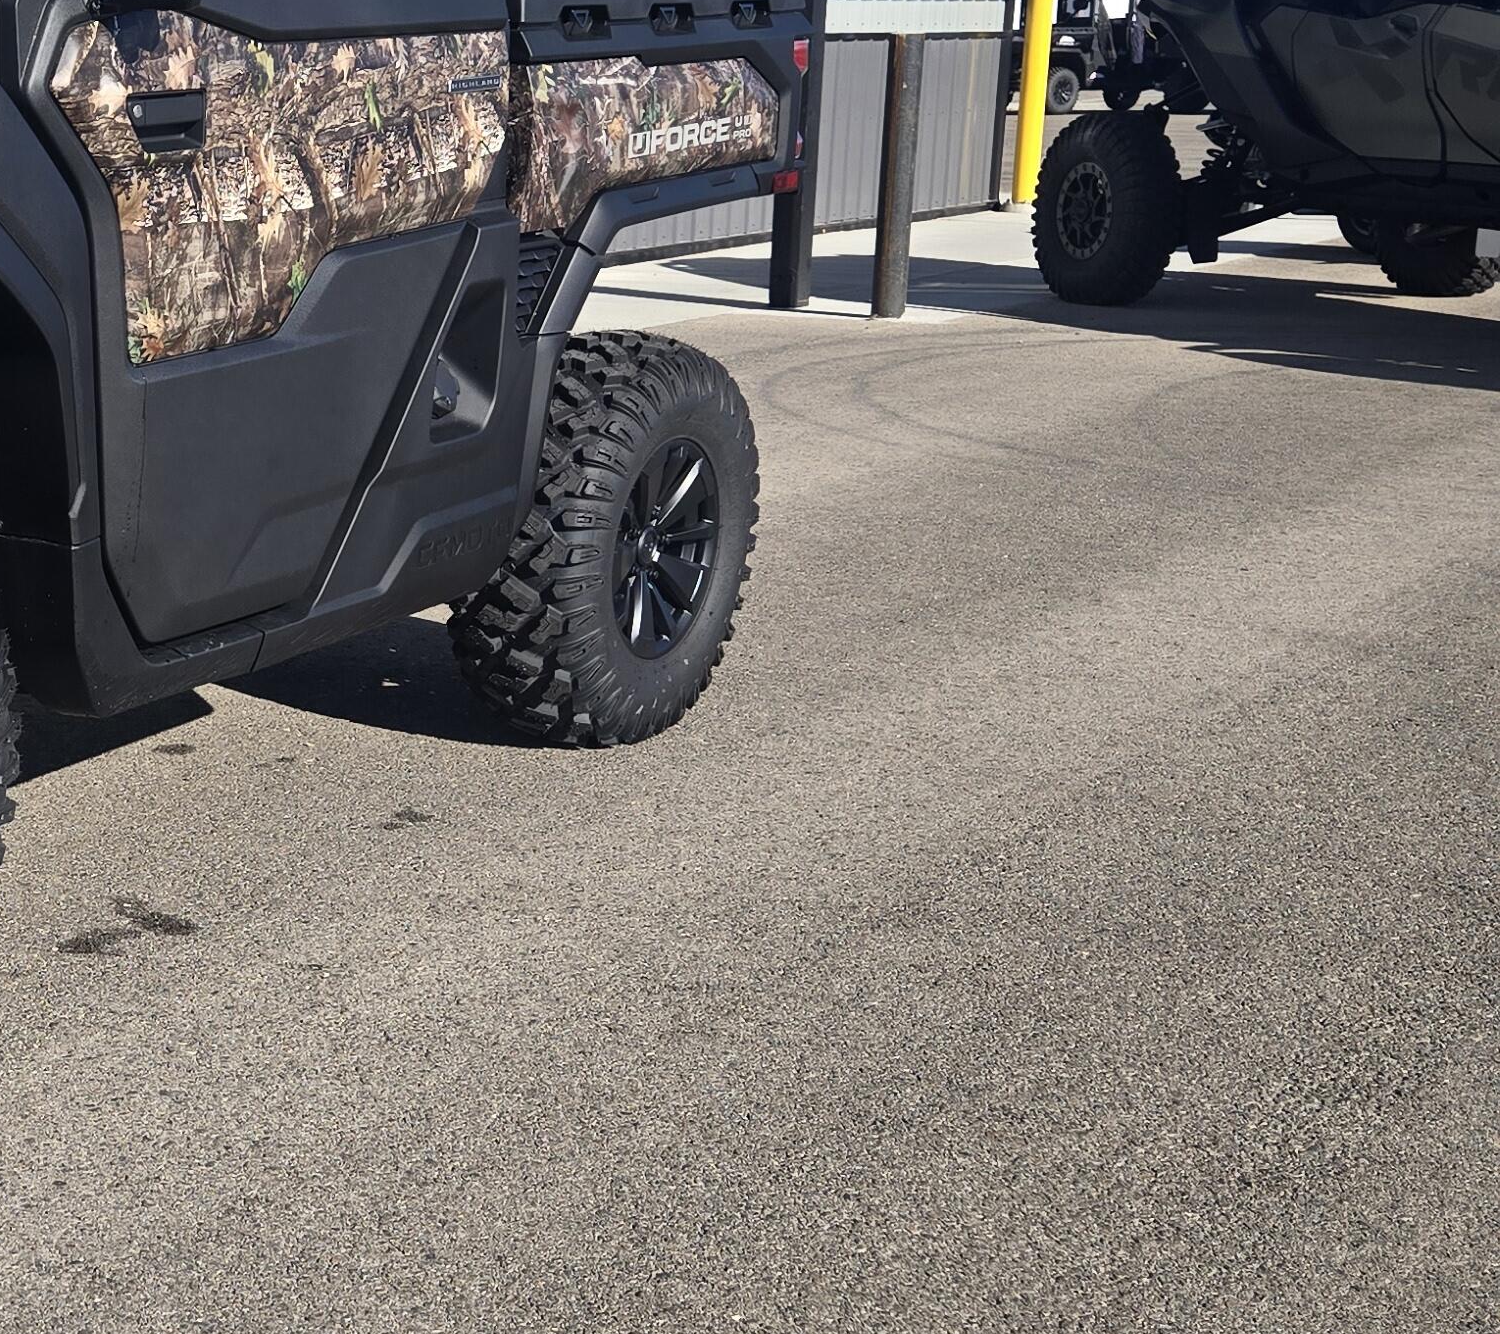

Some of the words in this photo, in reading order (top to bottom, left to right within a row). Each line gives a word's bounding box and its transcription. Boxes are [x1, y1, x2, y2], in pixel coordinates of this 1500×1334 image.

[451, 78, 500, 89] HIGHLAND
[628, 117, 731, 158] UFORCE
[733, 128, 752, 140] PRO
